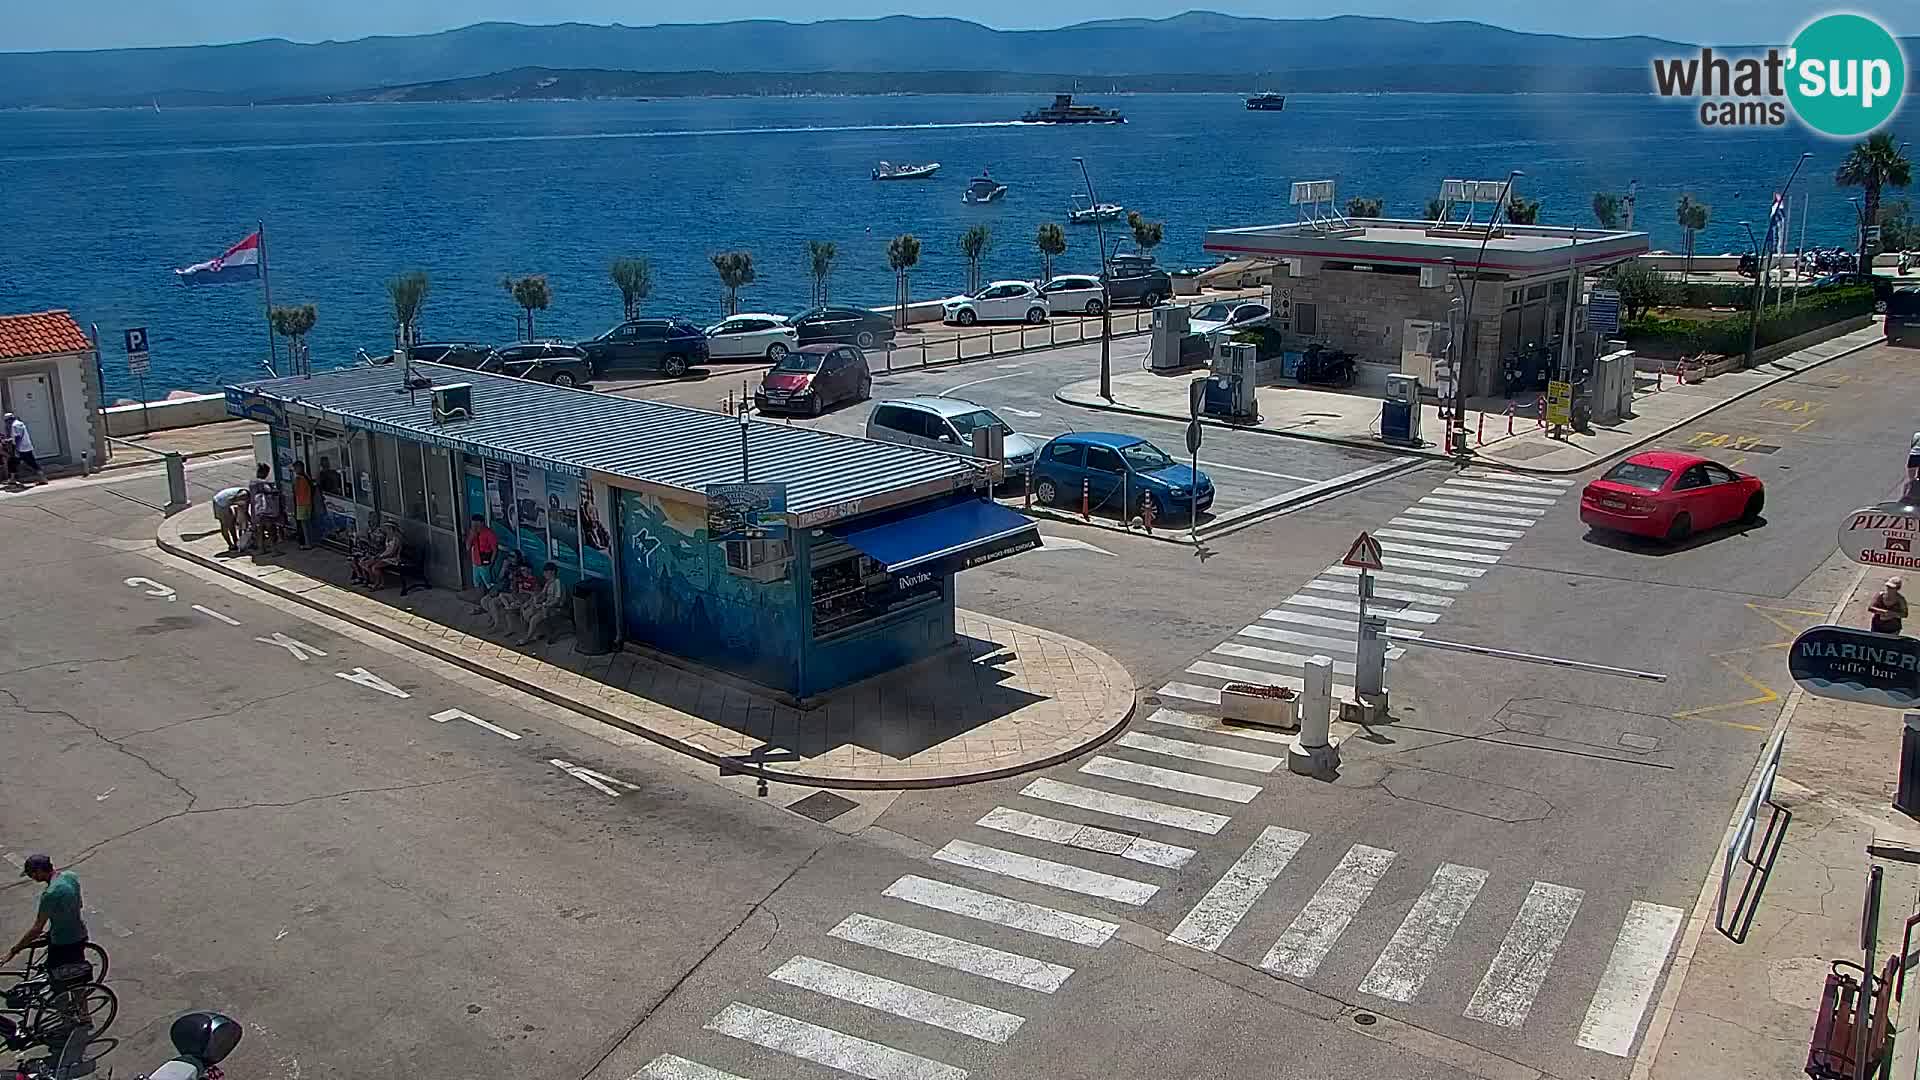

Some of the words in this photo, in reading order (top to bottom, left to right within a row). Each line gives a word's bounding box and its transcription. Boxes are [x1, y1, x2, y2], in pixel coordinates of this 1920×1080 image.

[130, 331, 142, 349] P
[477, 446, 493, 458] BUS
[493, 450, 526, 465] STATION
[528, 456, 554, 471] TICKET
[555, 462, 583, 477] OFFICE
[1848, 515, 1920, 533] PIZZE
[1800, 641, 1920, 673] MARINER
[1830, 662, 1866, 673] caffe
[1871, 665, 1897, 679] bar
